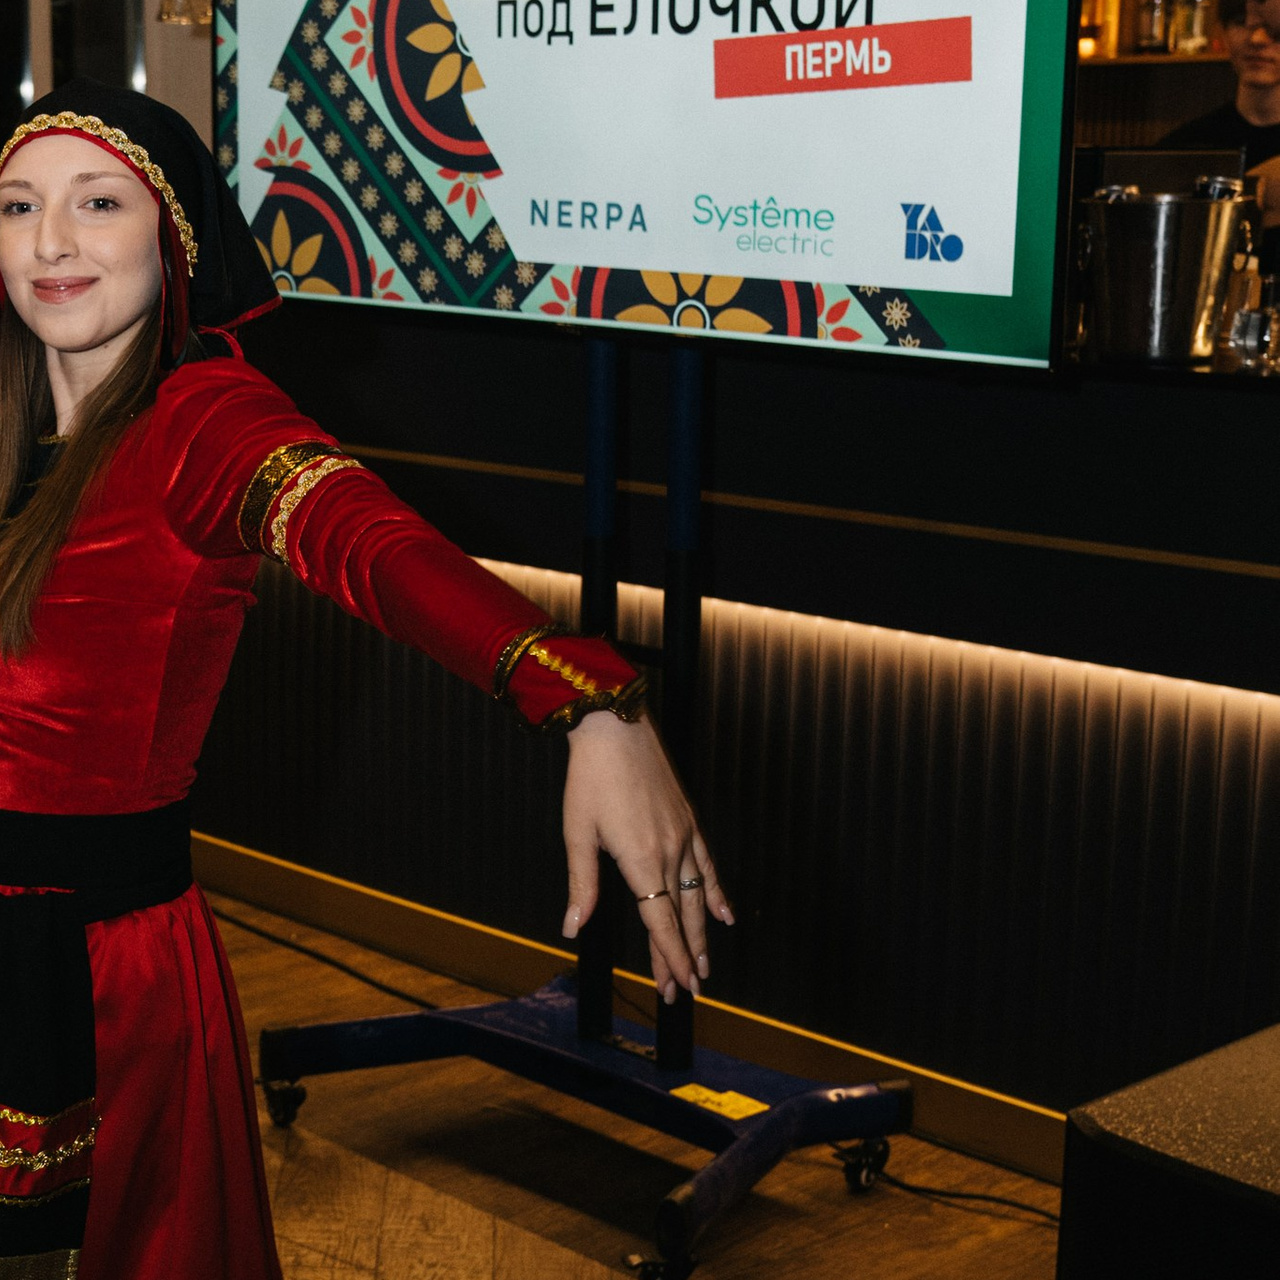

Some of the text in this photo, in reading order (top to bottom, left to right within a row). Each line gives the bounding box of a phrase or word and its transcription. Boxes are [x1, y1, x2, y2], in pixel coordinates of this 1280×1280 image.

[785, 38, 892, 81] ПЕРМЬ
[530, 194, 834, 232] NERPA Systême
[736, 229, 834, 257] electric
